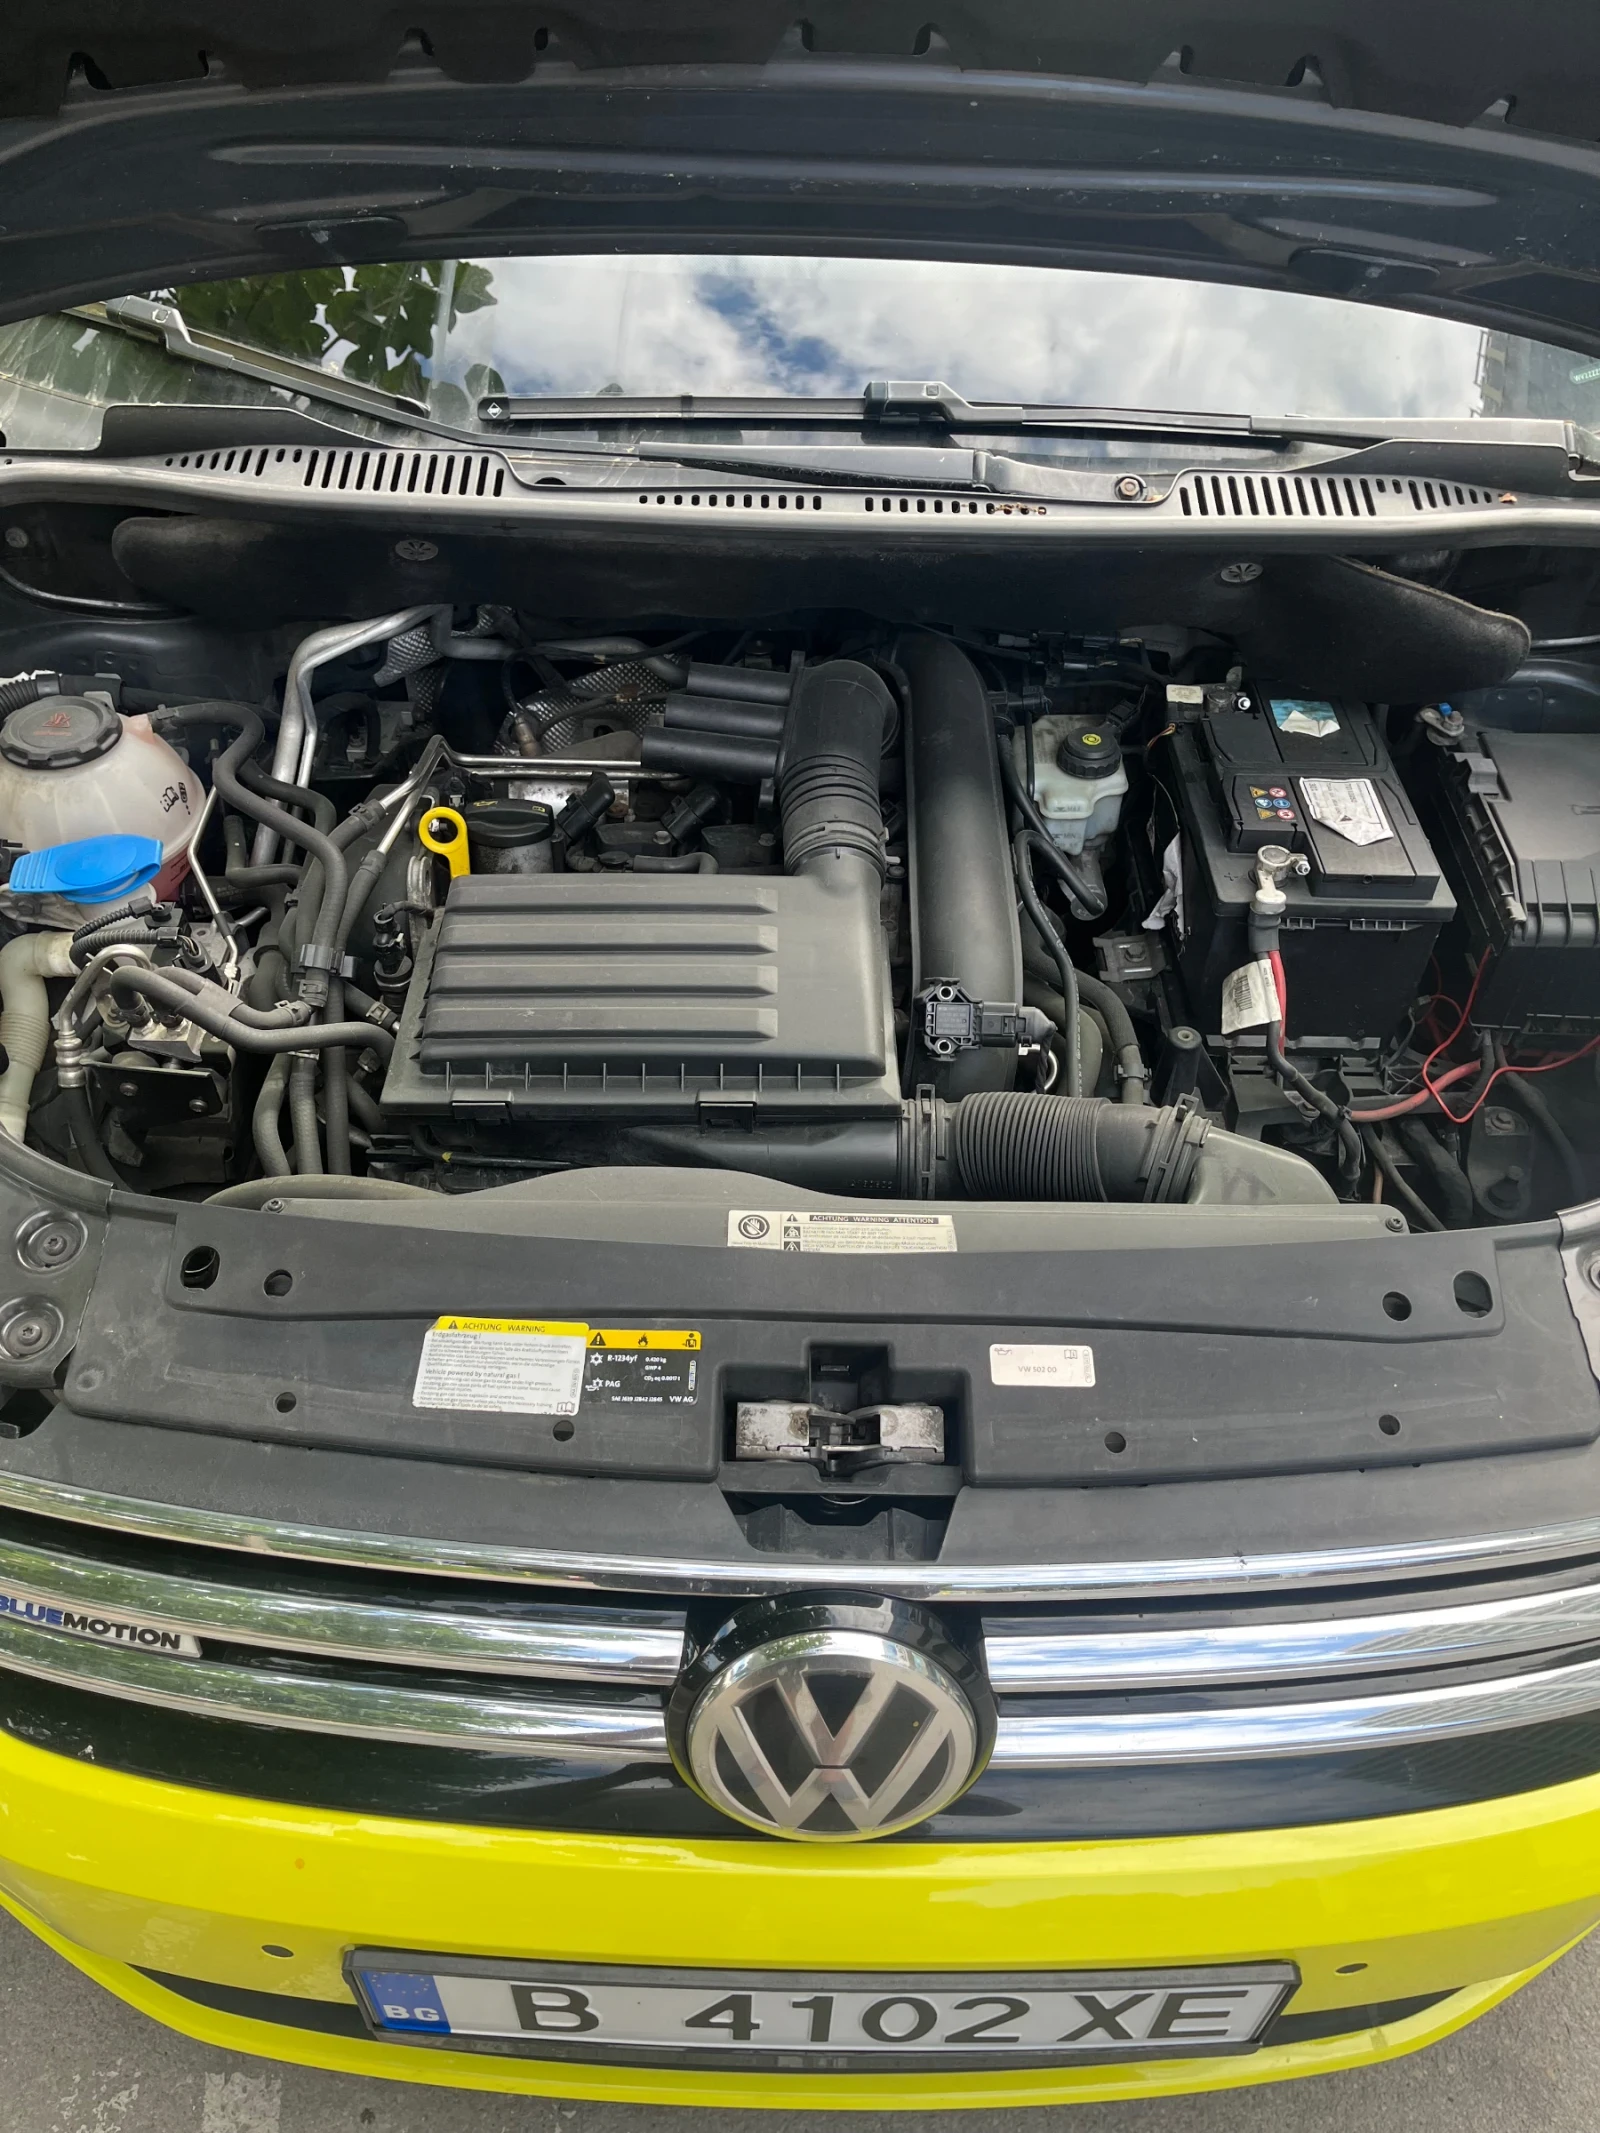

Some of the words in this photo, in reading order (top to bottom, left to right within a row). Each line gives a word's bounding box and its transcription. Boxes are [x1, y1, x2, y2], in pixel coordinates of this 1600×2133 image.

[463, 1322, 502, 1331] ACHTUNG
[507, 1324, 546, 1333] WARNING
[607, 1354, 638, 1364] R-1234yf
[604, 1380, 621, 1388] PAG
[683, 1395, 694, 1403] AG
[0, 1595, 181, 1650] BLUEMOTION
[692, 1640, 974, 1840] VW
[383, 2004, 440, 2022] BG
[510, 1984, 600, 2033] B
[685, 1994, 1031, 2043] 4102
[1056, 1990, 1250, 2042] XE
